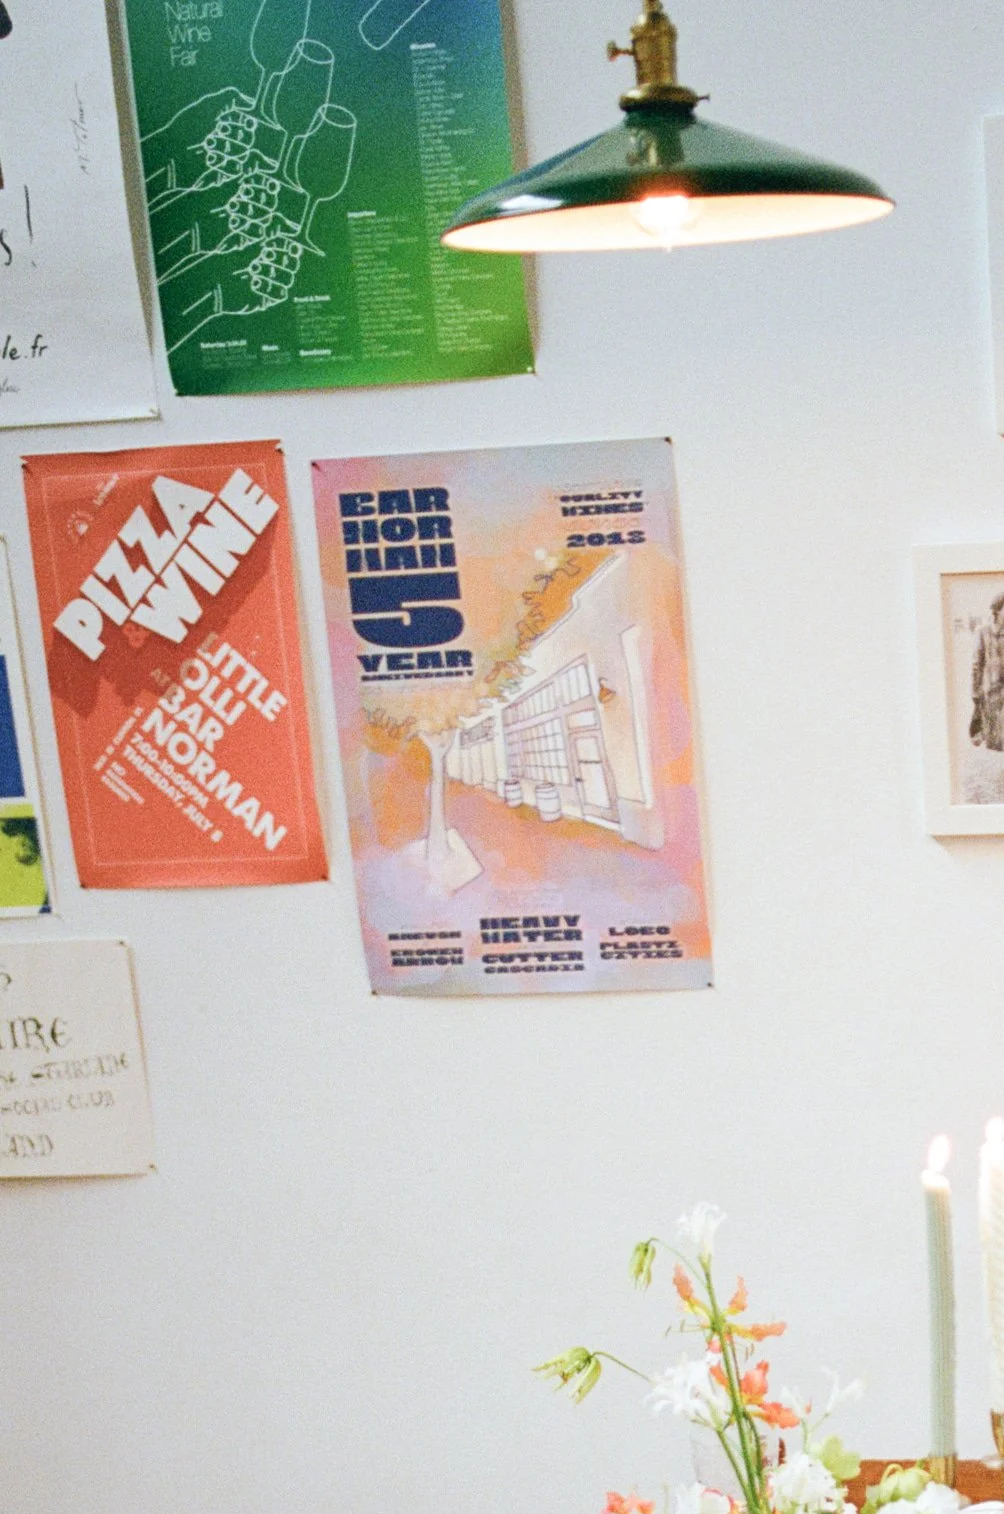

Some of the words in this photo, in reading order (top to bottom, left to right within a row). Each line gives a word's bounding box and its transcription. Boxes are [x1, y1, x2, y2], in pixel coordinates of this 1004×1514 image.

[166, 23, 212, 43] Wine
[338, 486, 450, 517] BAR
[53, 475, 216, 662] PIZZA
[129, 467, 280, 644] WINE
[347, 571, 464, 649] 5
[197, 632, 288, 721] LITTLE
[356, 650, 473, 673] YEAR
[158, 683, 225, 752] BAR
[140, 707, 288, 851] NORMAN
[182, 803, 214, 832] JULY
[479, 914, 581, 930] HEAVY
